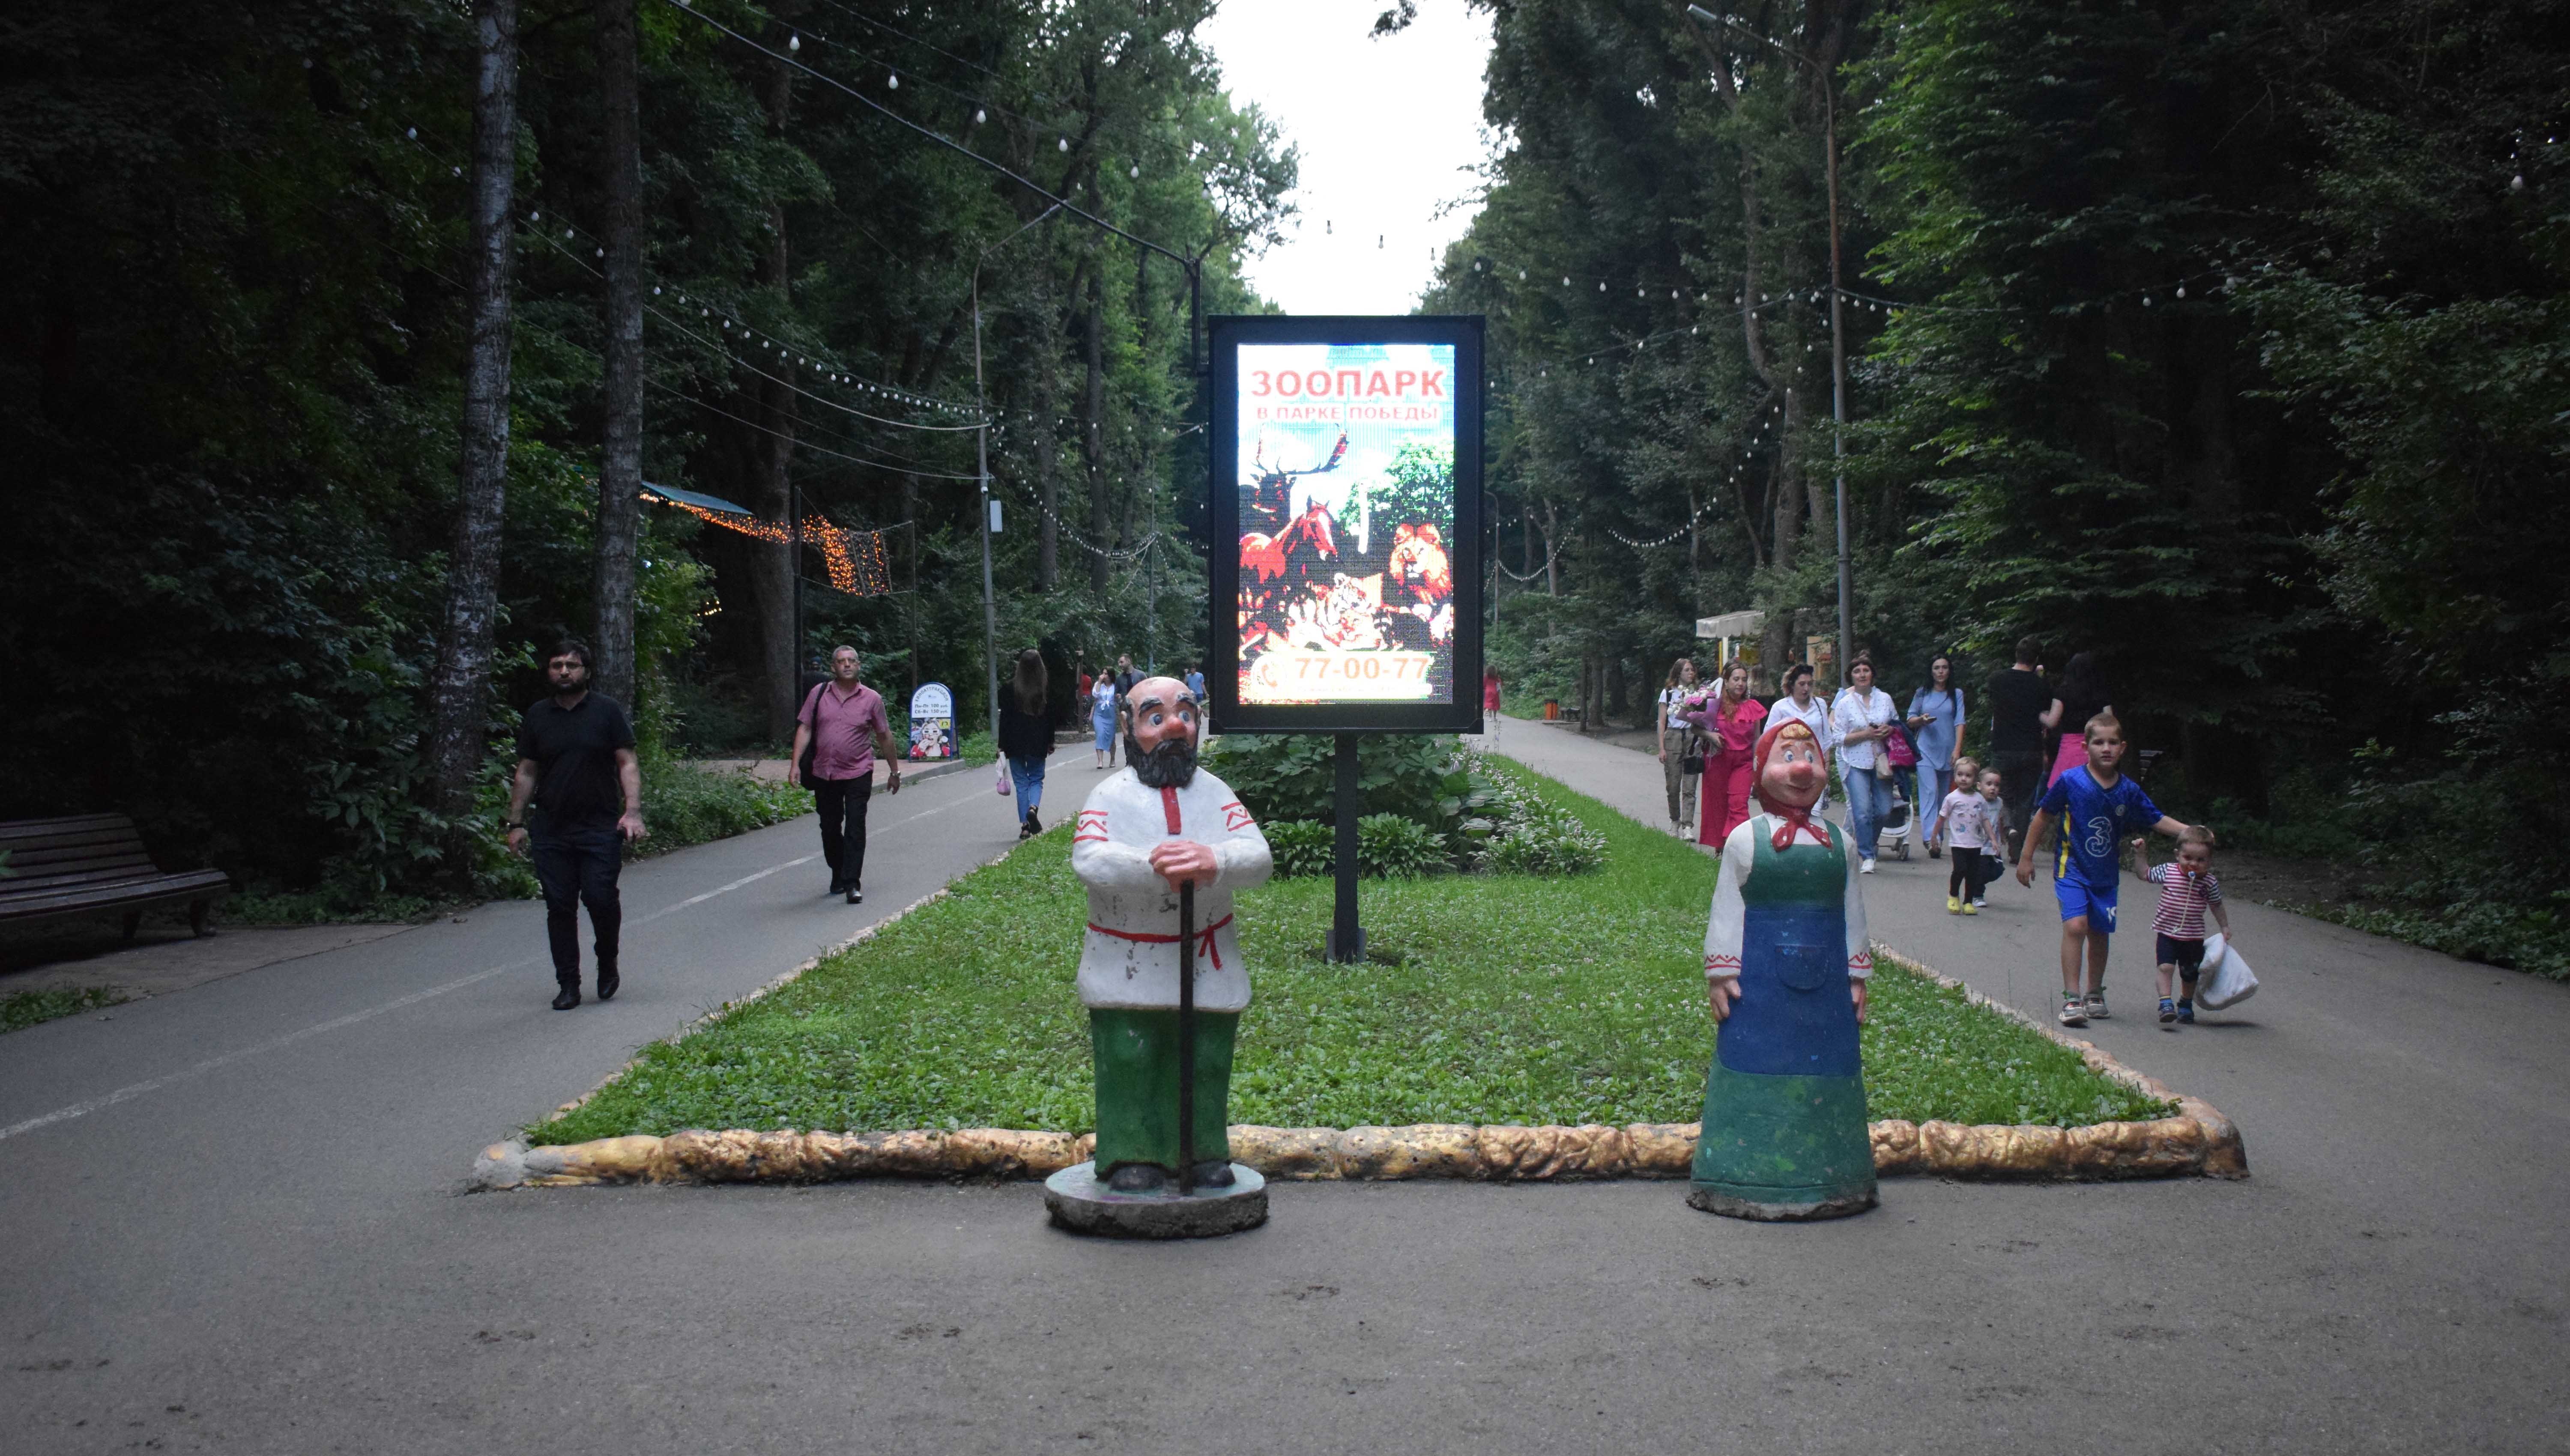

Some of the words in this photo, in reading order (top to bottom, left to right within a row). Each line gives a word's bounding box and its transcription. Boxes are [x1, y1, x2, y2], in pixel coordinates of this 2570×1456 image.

[1251, 370, 1443, 396] ЗООПАРК
[1257, 408, 1267, 419] В
[1277, 408, 1340, 419] ПАРКЕ
[1350, 408, 1437, 421] ПОБЕДЫ
[1295, 657, 1428, 679] 77-00-77
[2085, 816, 2112, 857] 3
